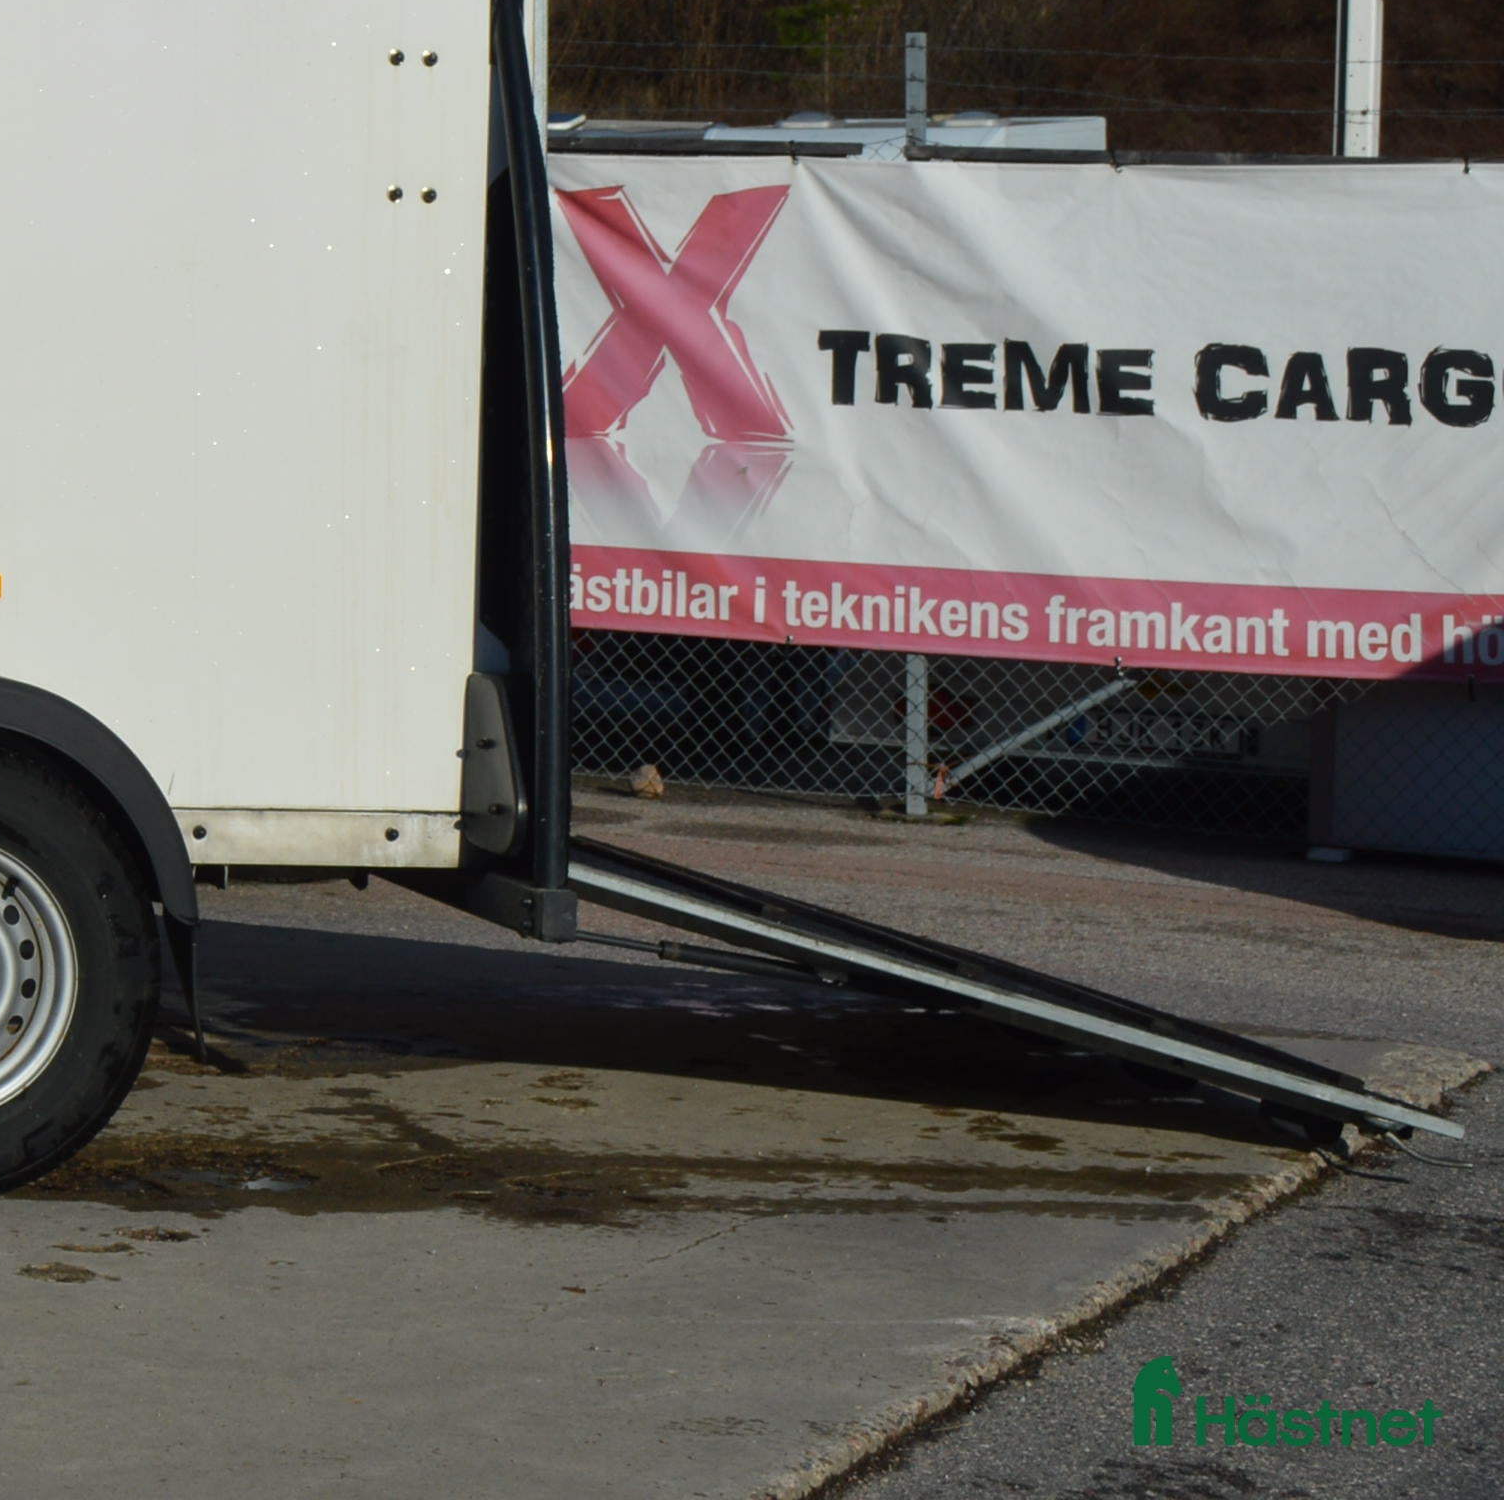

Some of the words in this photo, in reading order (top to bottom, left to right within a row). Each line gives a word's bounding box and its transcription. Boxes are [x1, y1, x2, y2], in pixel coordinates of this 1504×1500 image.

[1193, 342, 1504, 428] CARG
[754, 576, 767, 624] i
[783, 580, 1029, 641] teknikens
[1046, 595, 1289, 657] framkant
[1306, 613, 1422, 663] med
